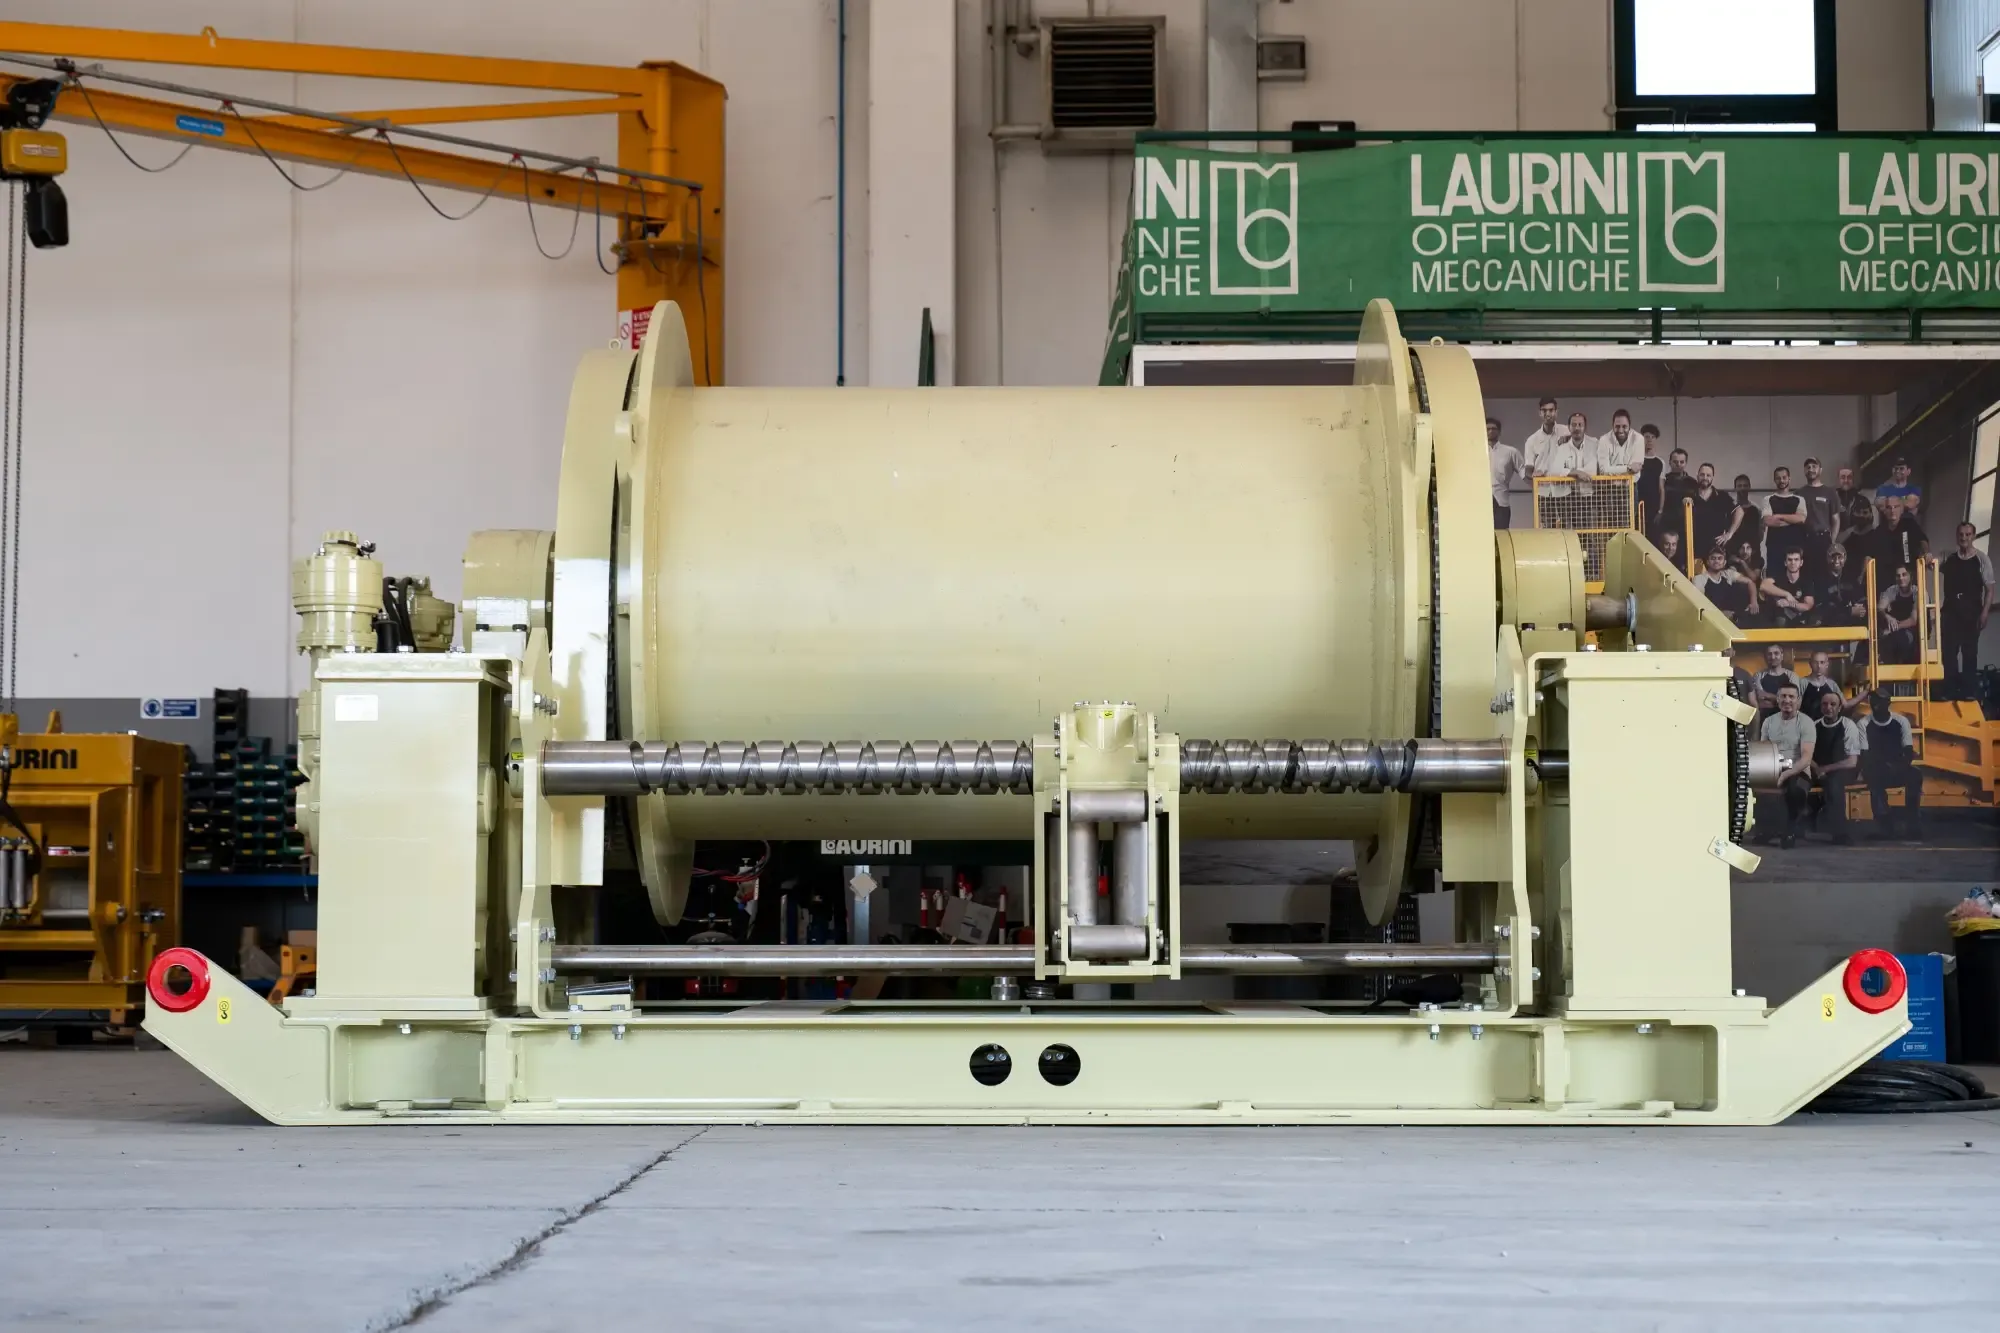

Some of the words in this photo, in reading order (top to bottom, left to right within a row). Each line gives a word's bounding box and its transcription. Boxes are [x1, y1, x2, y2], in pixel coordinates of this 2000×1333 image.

[1411, 152, 1629, 217] LAURINI
[1838, 152, 2000, 216] LAURI
[1138, 226, 1200, 259] NE
[1411, 221, 1630, 256] OFFICINE
[1838, 222, 2000, 256] OFFICI
[1138, 263, 1201, 297] CHE
[1411, 258, 1630, 293] MECCANICHE
[821, 839, 912, 855] LAURINI
